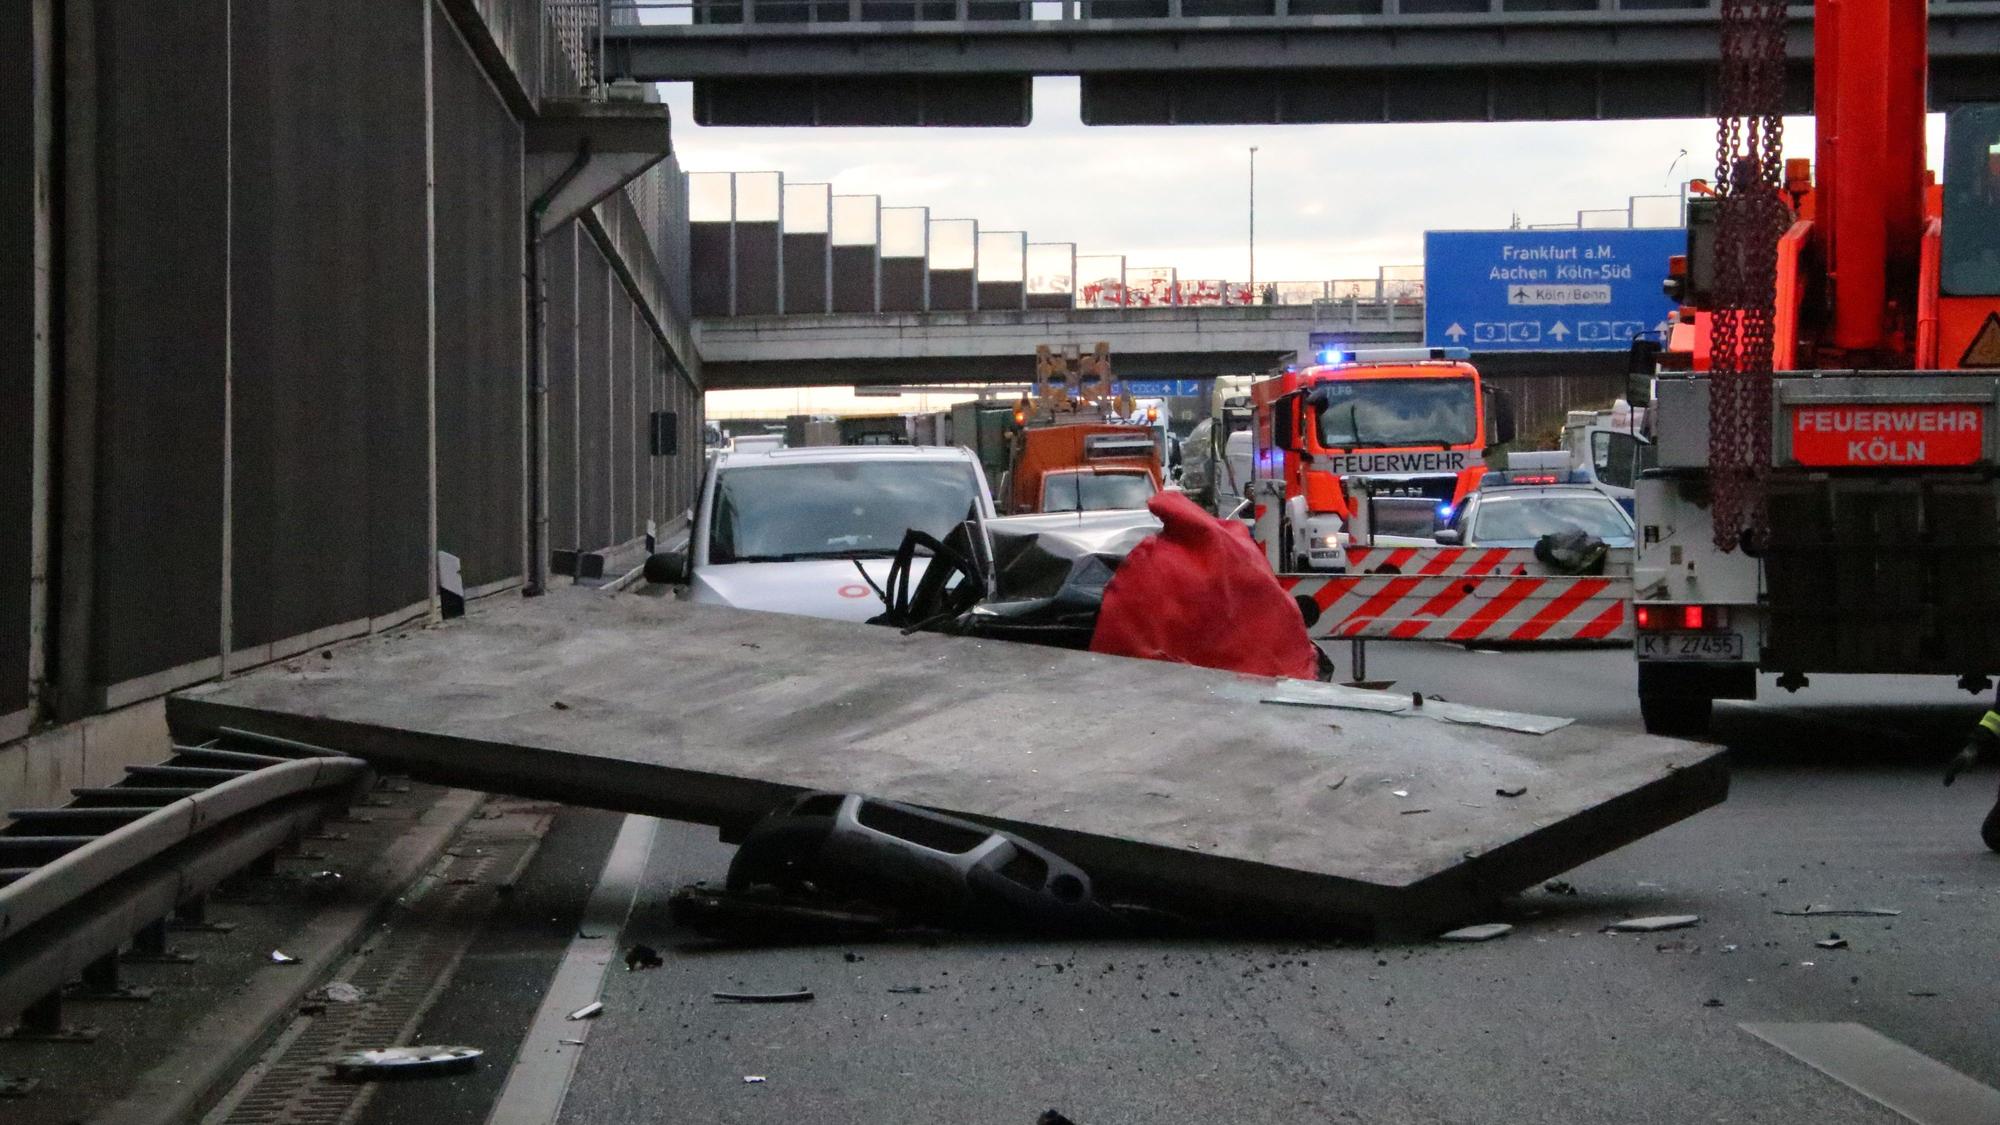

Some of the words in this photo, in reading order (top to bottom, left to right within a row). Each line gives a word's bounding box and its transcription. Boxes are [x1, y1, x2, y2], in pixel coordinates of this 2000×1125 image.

[1503, 245, 1577, 260] Frankfurt
[1584, 246, 1616, 260] a.M.
[1489, 266, 1547, 280] Aachen
[1557, 264, 1632, 279] Köln-Süd
[1800, 411, 1977, 432] FEUERWEHR
[1848, 436, 1926, 461] KÖLN
[1333, 452, 1464, 474] FEUERWEHR
[1645, 636, 1657, 653] K
[1681, 636, 1734, 654] 27455
